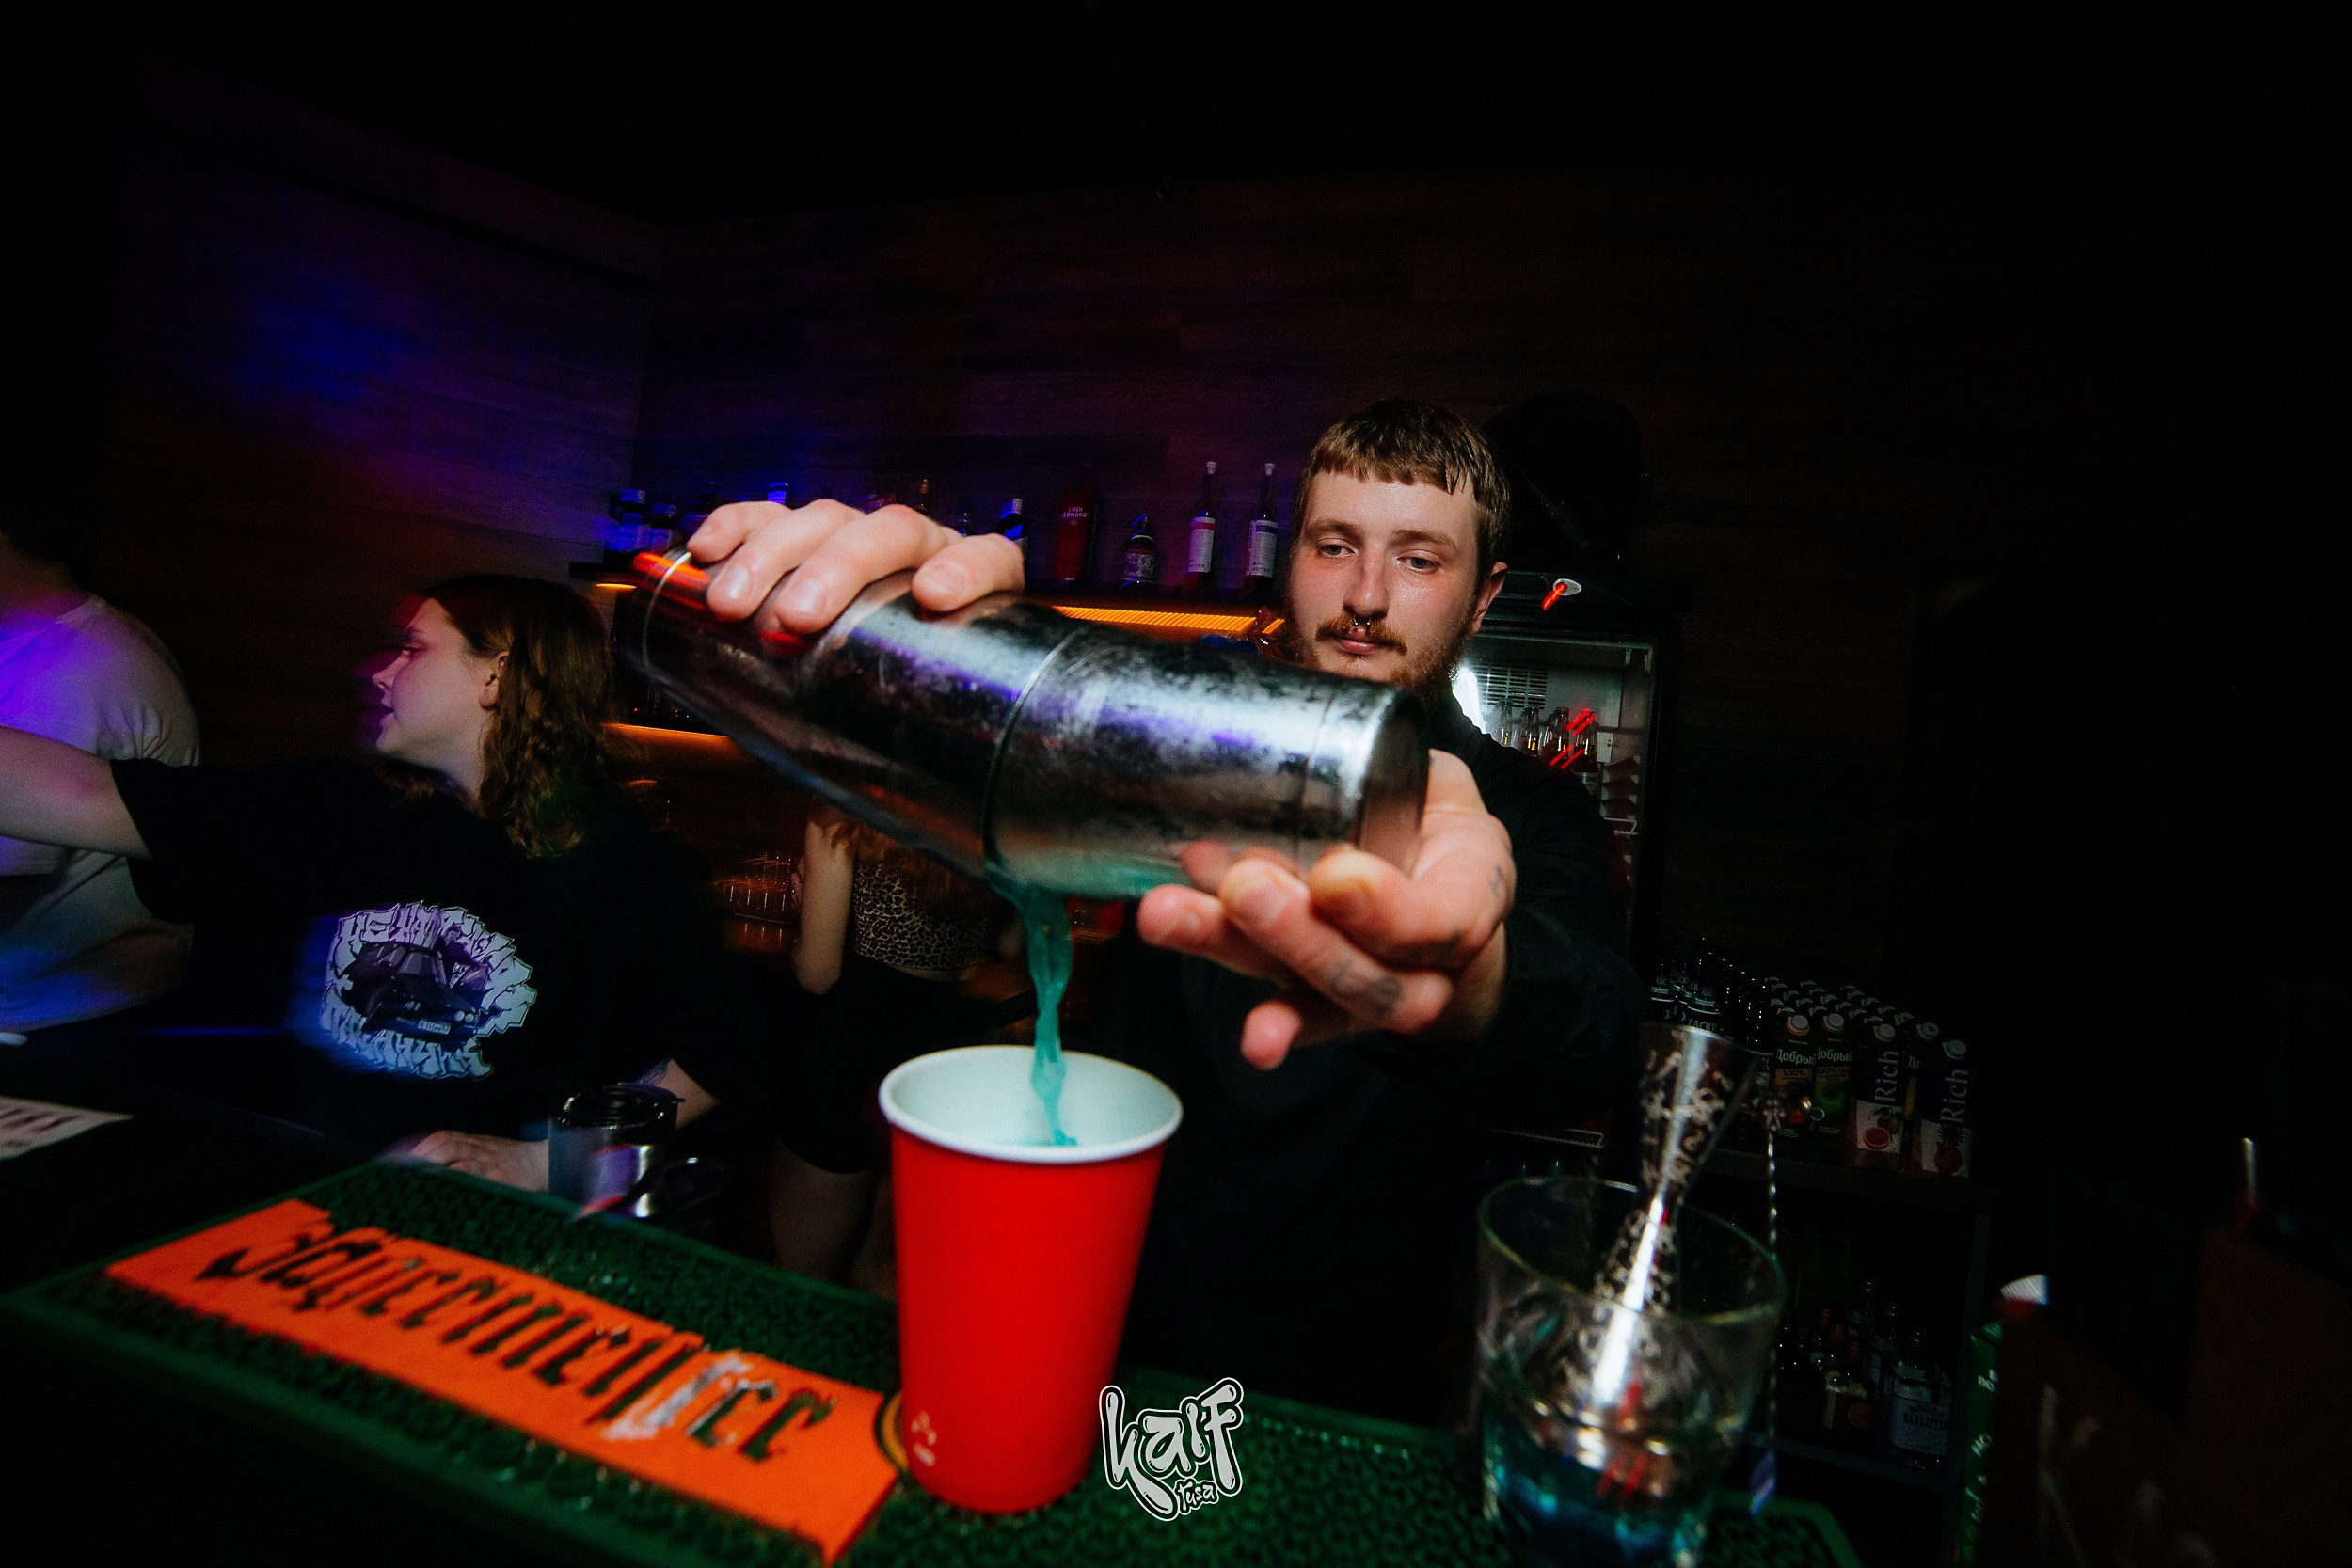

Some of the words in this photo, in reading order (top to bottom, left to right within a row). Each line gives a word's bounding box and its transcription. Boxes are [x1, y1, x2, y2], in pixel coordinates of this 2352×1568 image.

[1818, 1047, 1853, 1063] обрый
[1874, 1051, 1899, 1102] Rich
[1940, 1069, 1969, 1123] Rich
